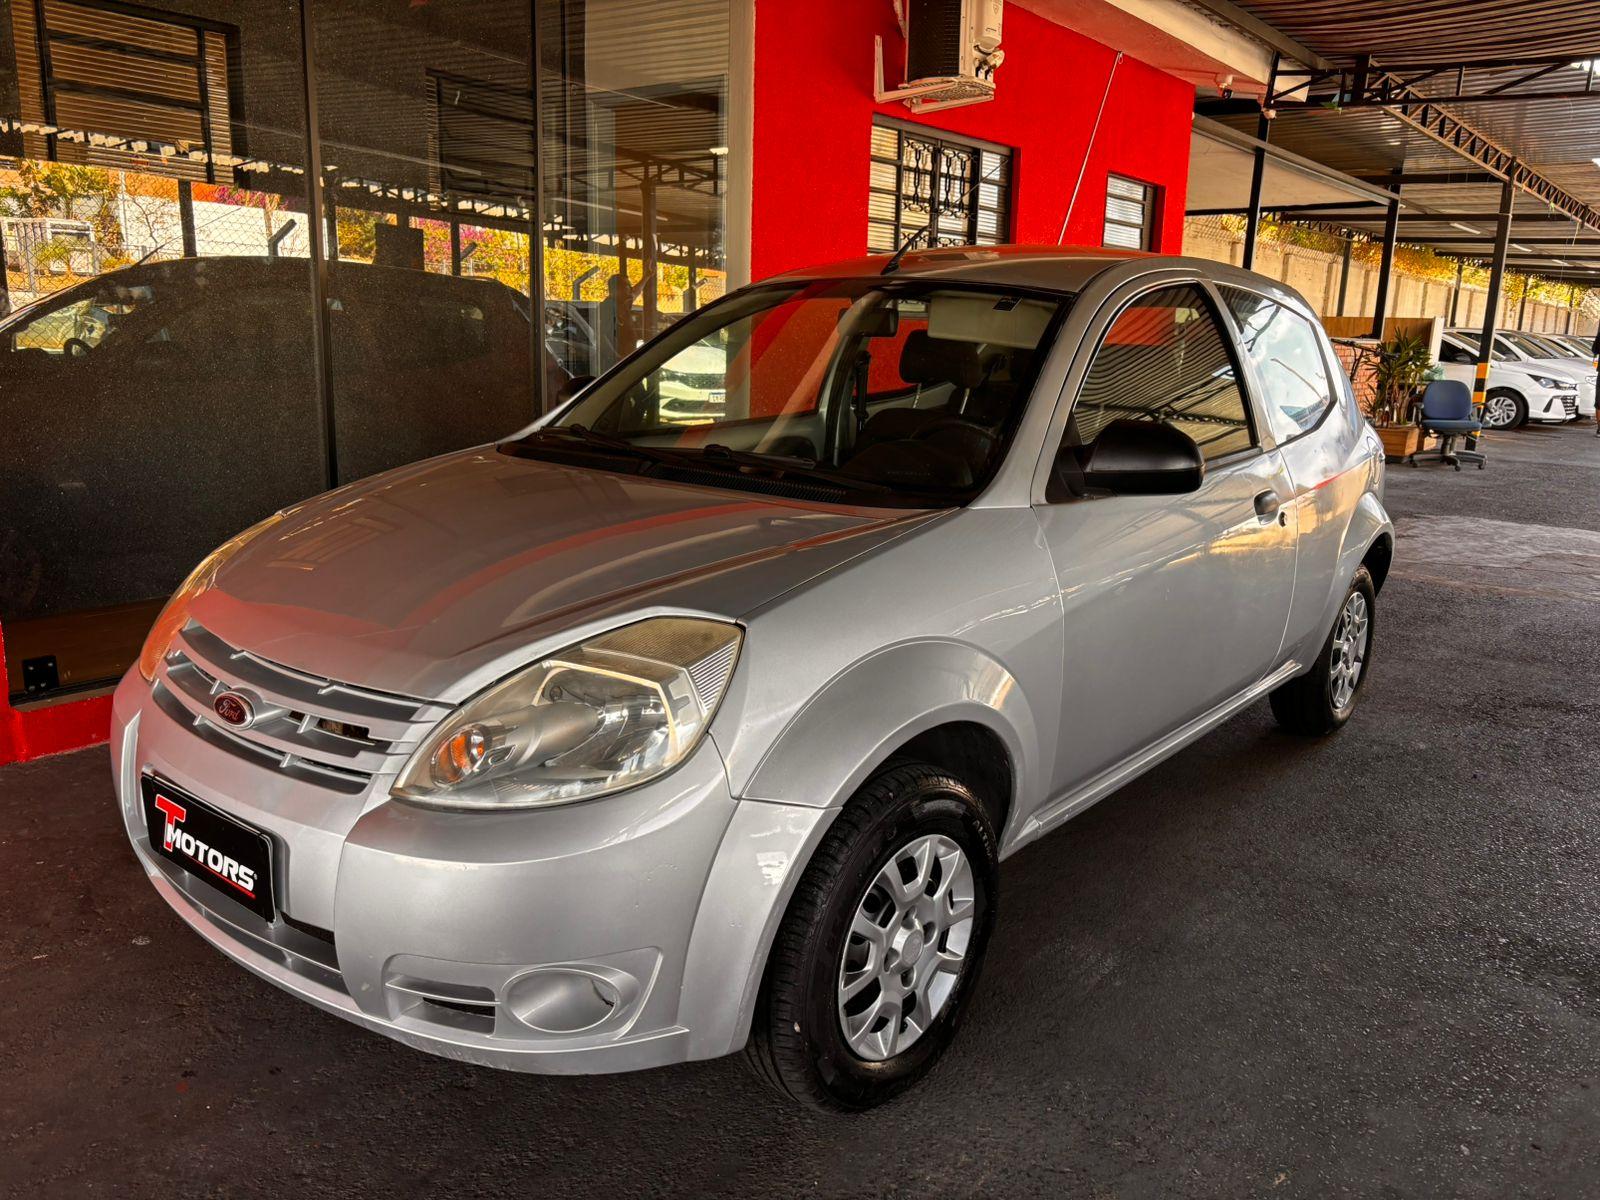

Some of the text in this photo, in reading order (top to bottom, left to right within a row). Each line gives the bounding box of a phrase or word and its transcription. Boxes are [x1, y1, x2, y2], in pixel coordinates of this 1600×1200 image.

[219, 699, 240, 721] Ford
[155, 794, 256, 892] T MOTORS
